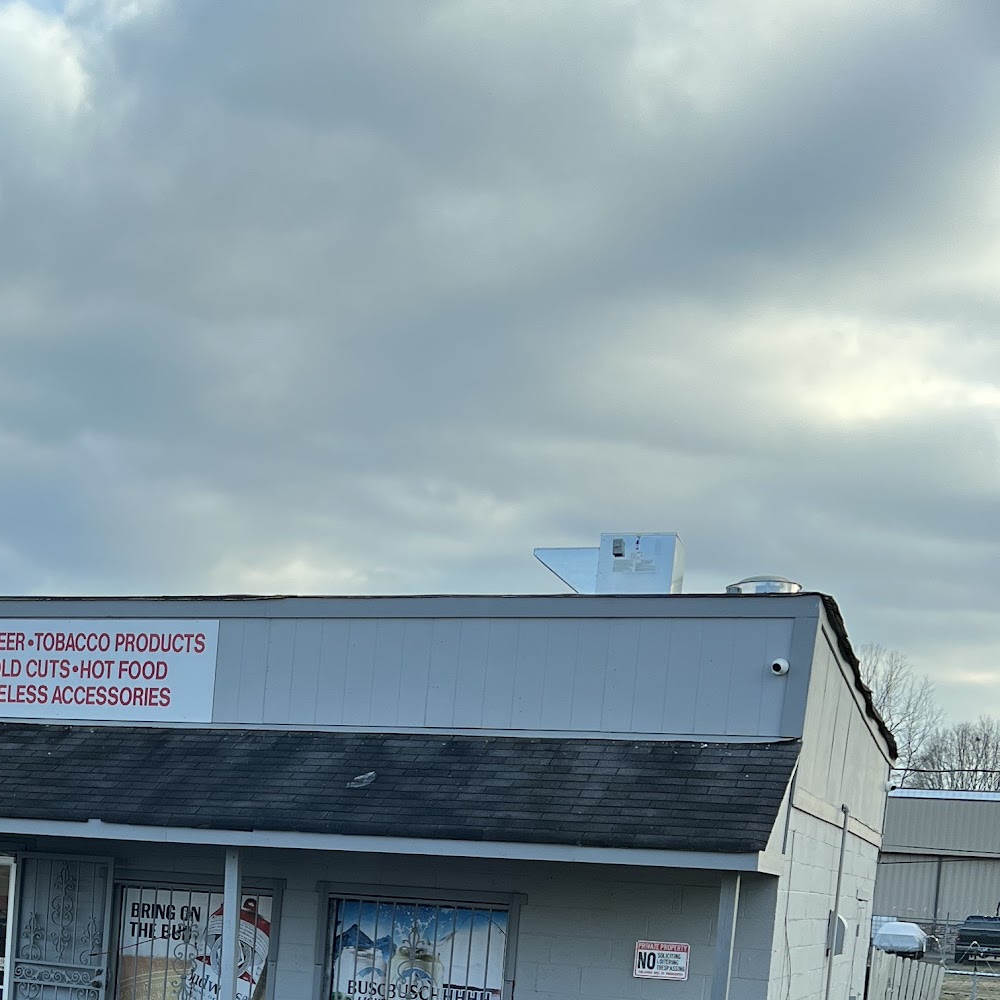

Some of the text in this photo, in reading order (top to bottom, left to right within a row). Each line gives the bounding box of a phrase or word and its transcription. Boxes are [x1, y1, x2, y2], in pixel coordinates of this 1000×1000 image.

[34, 632, 110, 652] TOBACCO
[115, 633, 206, 653] PRODUCTS
[26, 659, 71, 679] CUTS
[80, 660, 115, 679] HOT
[118, 660, 168, 680] FOOD
[51, 685, 171, 707] ACCESSORIES
[131, 902, 201, 922] BRING ON
[130, 921, 157, 939] THE
[660, 944, 688, 953] PROPERTY
[637, 951, 657, 970] NO
